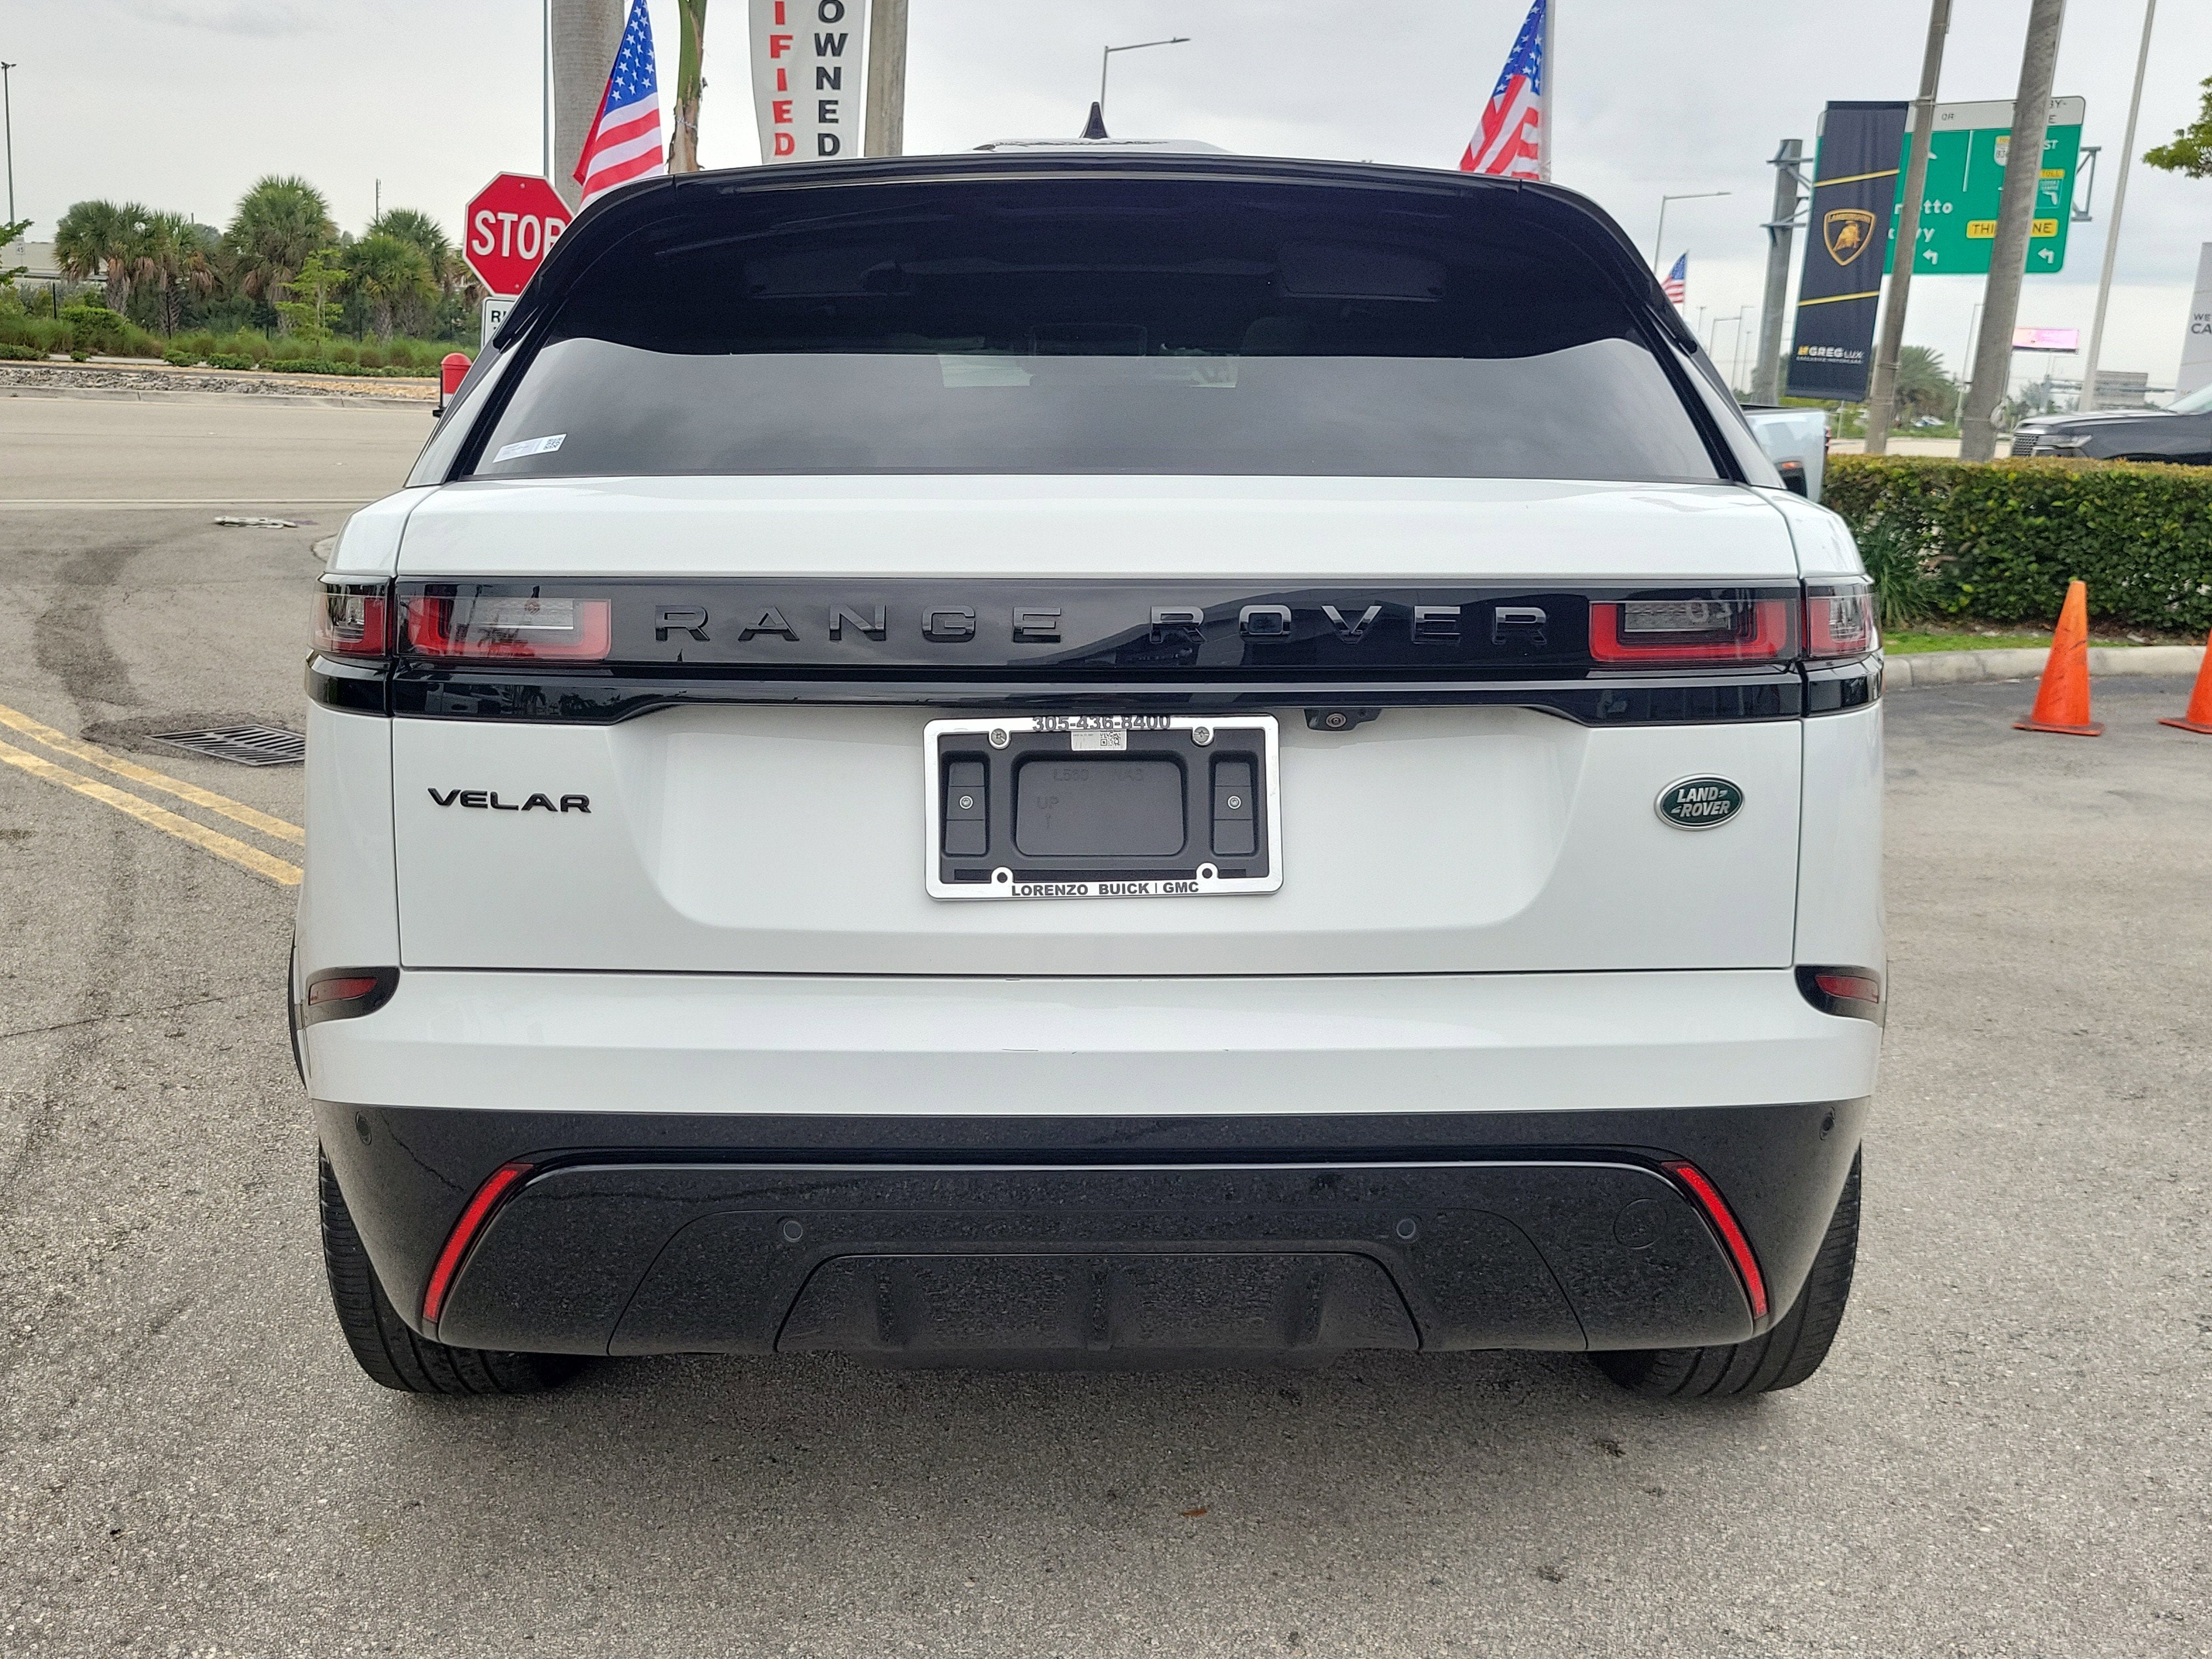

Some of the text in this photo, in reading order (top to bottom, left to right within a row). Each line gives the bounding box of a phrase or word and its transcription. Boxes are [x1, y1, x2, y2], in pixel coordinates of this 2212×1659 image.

[814, 0, 849, 156] OWNED
[1973, 223, 1996, 235] THI
[654, 604, 1548, 645] RANGE ROVER
[1032, 715, 1171, 731] 305-436-8400
[428, 787, 591, 813] VELAR
[1677, 787, 1719, 803] LAND
[1680, 800, 1731, 817] ROVER
[1012, 881, 1199, 896] LORENZO BUICK GMC
